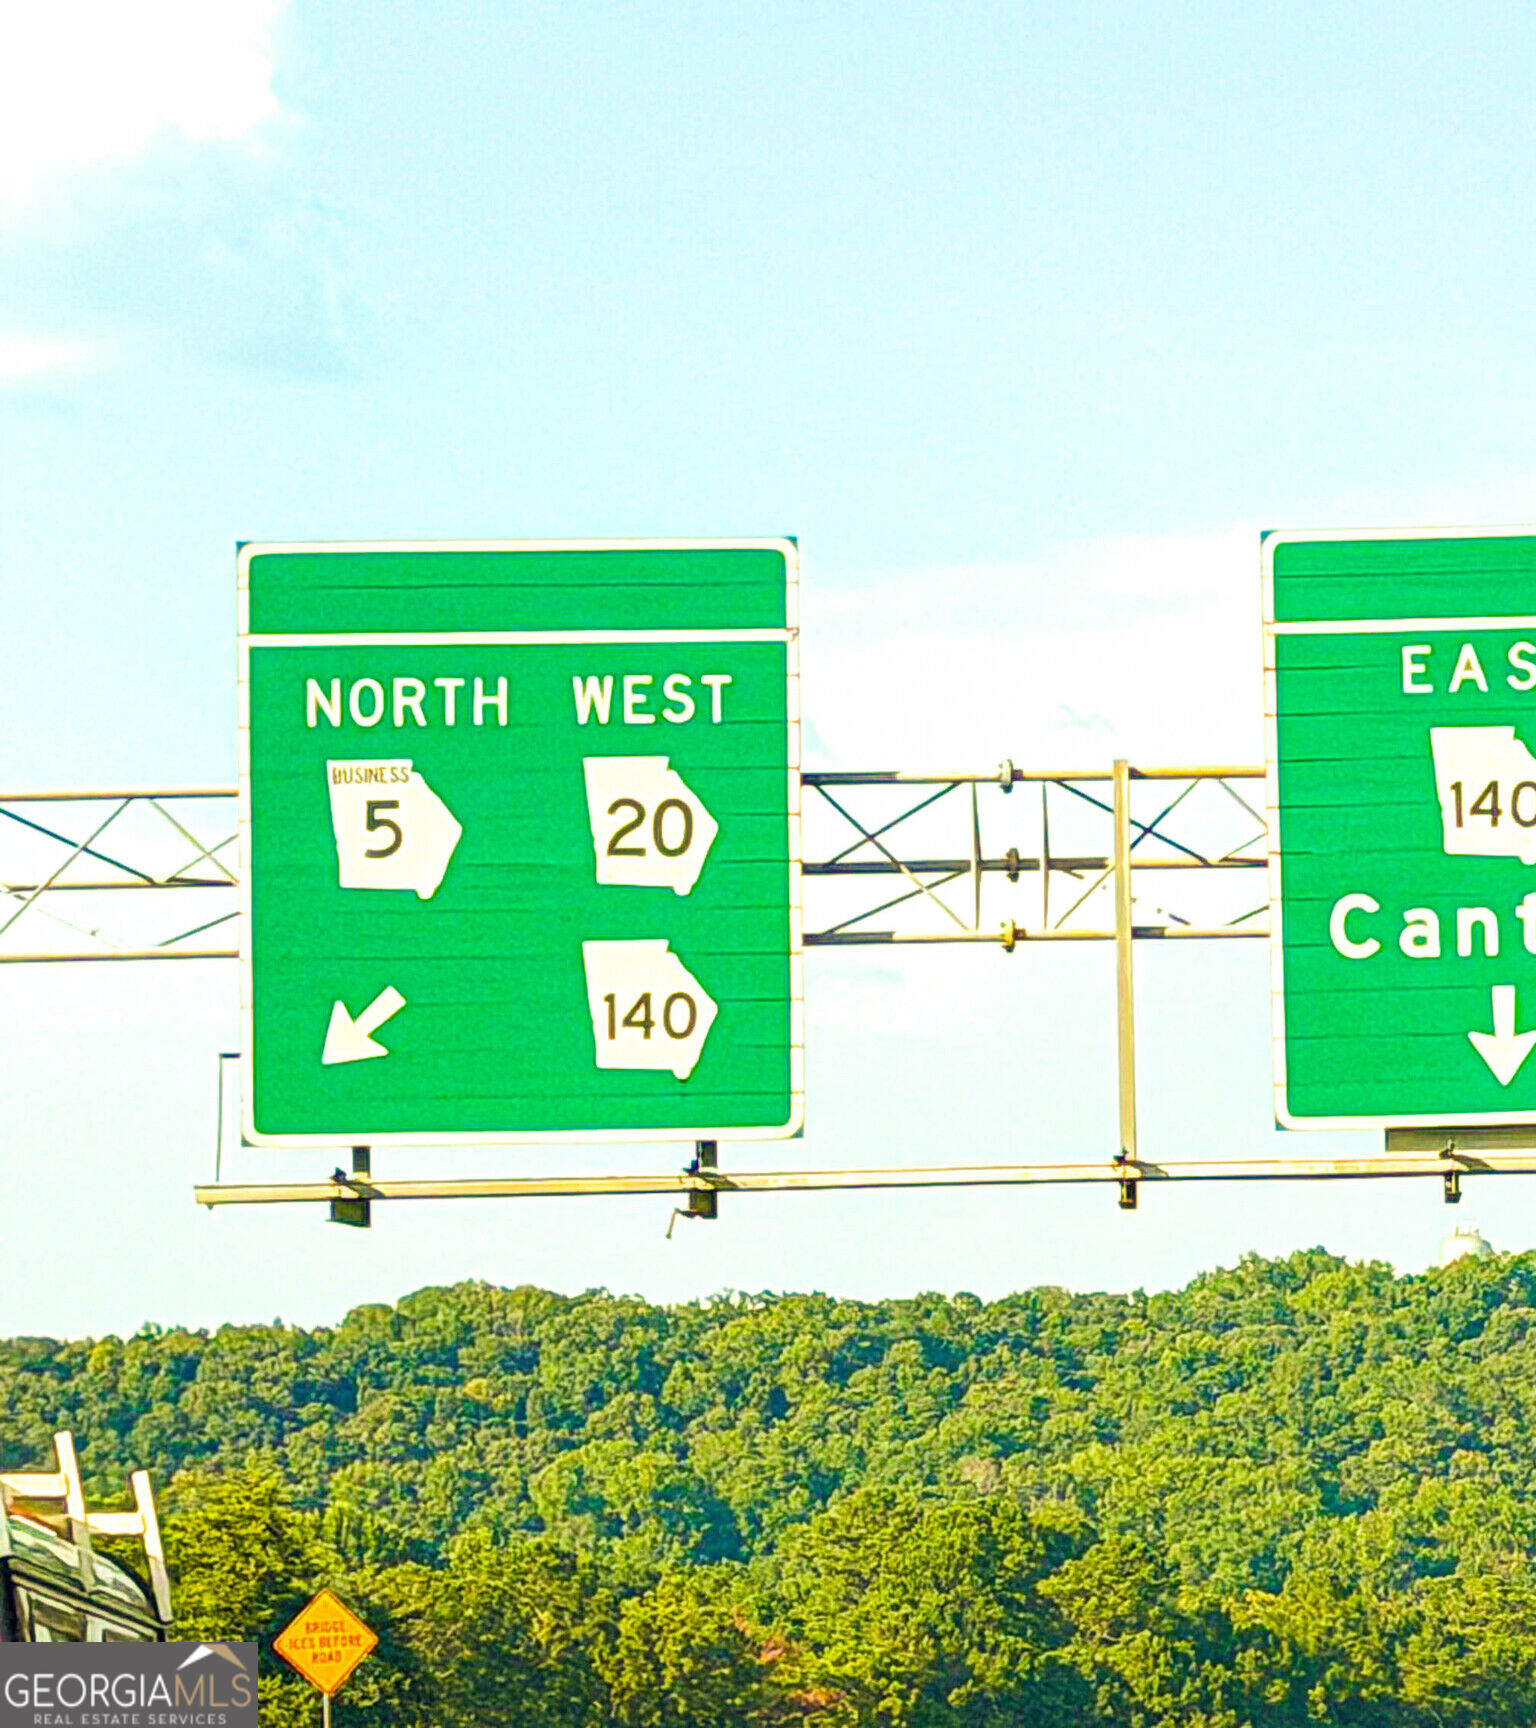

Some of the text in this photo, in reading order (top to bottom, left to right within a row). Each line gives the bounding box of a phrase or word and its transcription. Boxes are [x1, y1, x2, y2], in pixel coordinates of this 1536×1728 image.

[306, 676, 509, 728] NORTH
[572, 673, 733, 725] WEST
[332, 766, 410, 784] BUSINESS
[364, 800, 403, 859] 5
[606, 798, 694, 857] 20
[603, 992, 698, 1040] 140
[305, 1621, 345, 1634] BRIDGE
[318, 1634, 362, 1648] BEFORE
[312, 1650, 342, 1664] ROAD
